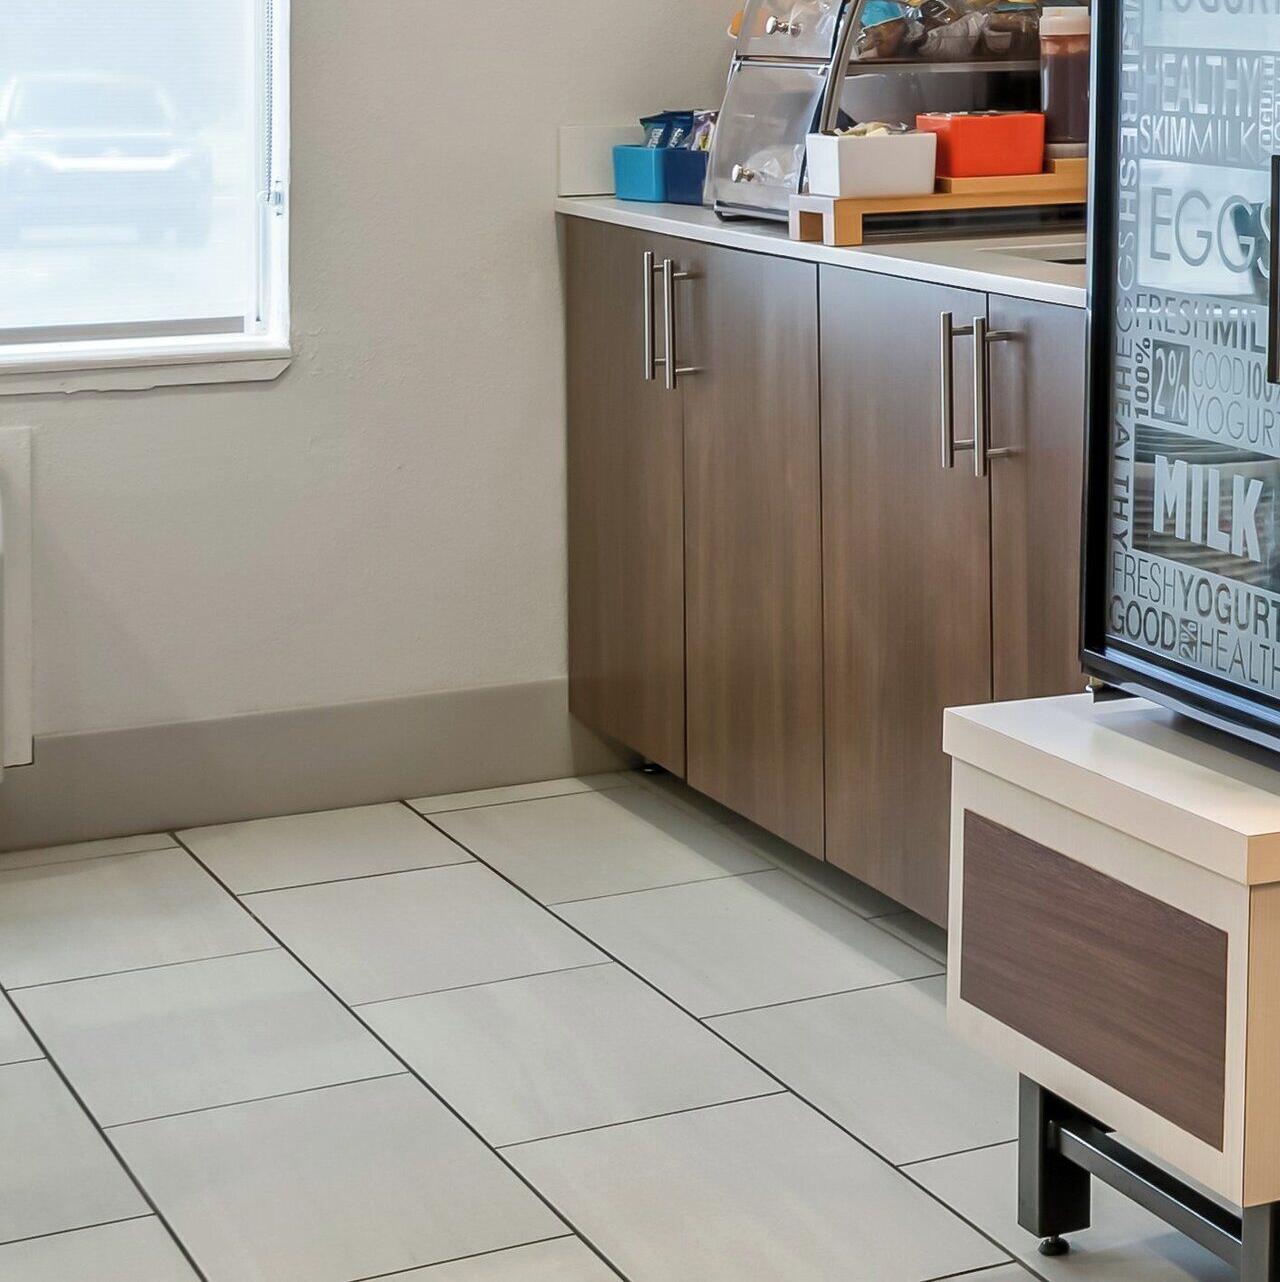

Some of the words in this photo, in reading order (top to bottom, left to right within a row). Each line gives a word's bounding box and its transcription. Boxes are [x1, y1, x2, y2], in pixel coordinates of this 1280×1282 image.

[1142, 53, 1259, 118] HEALTHY
[1139, 114, 1187, 158] SKIM
[1188, 117, 1257, 163] MILK
[1136, 292, 1211, 341] FRESH
[1212, 304, 1268, 355] MIL
[1154, 347, 1187, 420] 2%
[1191, 348, 1246, 396] GOOD
[1152, 453, 1264, 563] MILK
[1112, 549, 1176, 609] FRESH
[1109, 595, 1177, 651] GOOD
